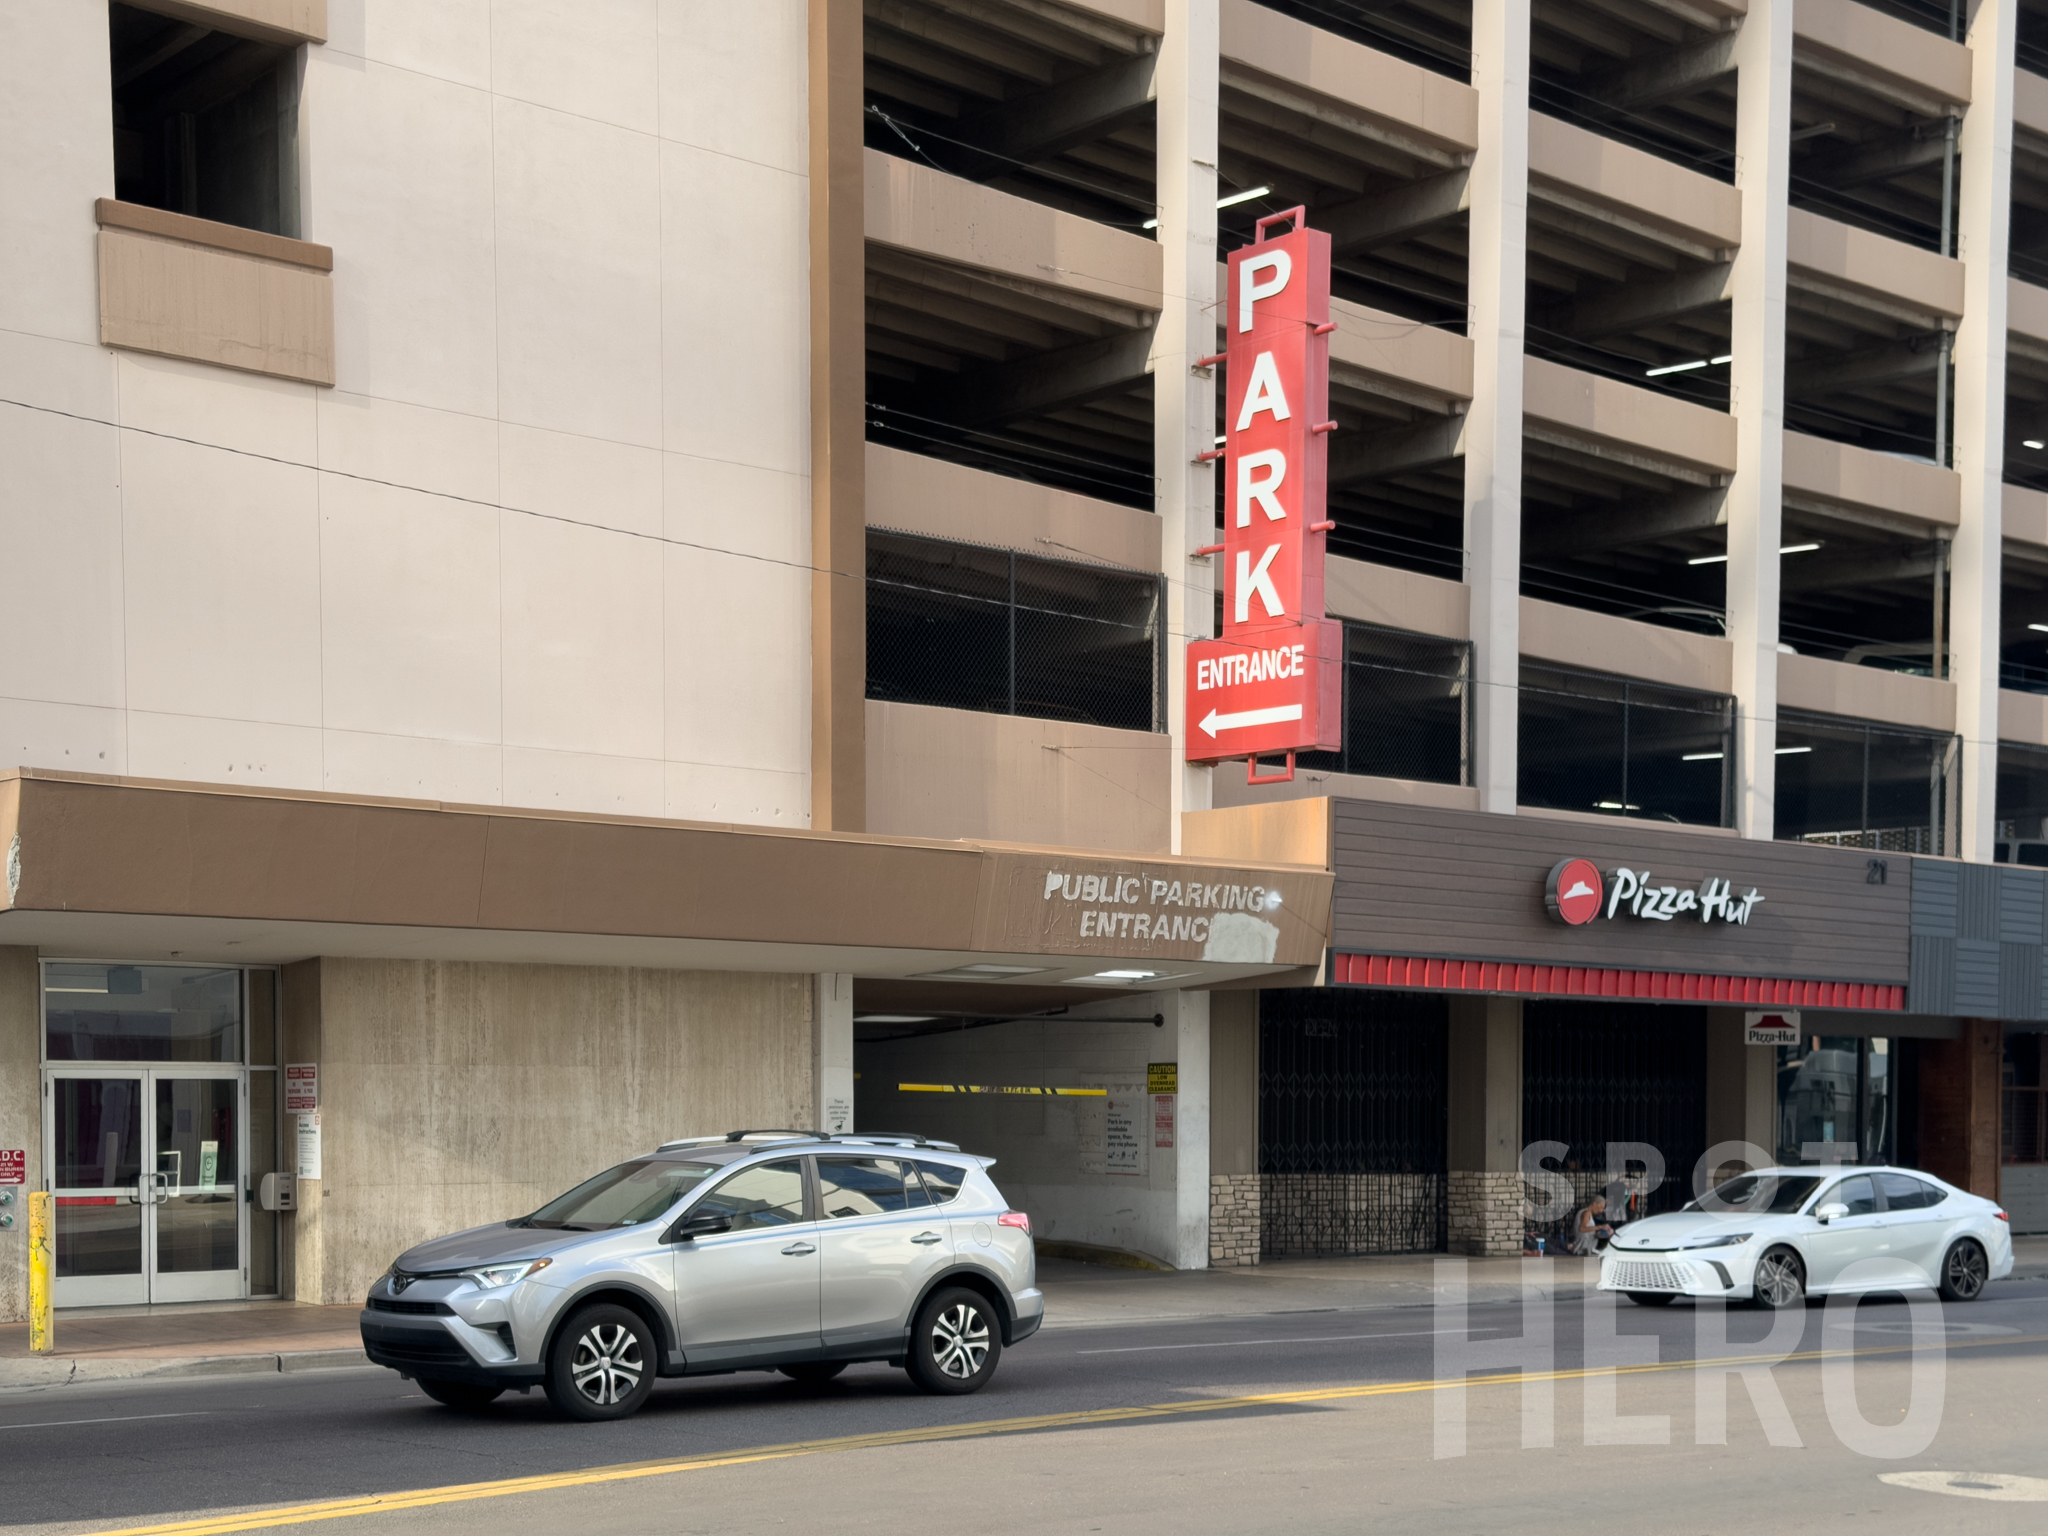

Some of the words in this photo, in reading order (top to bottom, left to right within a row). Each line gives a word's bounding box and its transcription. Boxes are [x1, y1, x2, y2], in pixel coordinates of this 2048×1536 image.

[1235, 249, 1292, 623] PARK
[1197, 644, 1304, 691] ENTRANCE
[1867, 859, 1887, 884] 21
[1044, 871, 1140, 904] PUBLIC
[1150, 880, 1266, 912] PARKING
[1607, 867, 1698, 921] Pizza
[1700, 877, 1766, 926] Hut
[1080, 911, 1214, 943] ENTRANC
[1149, 1065, 1176, 1073] CAUTION
[0, 1151, 24, 1161] .D.C.
